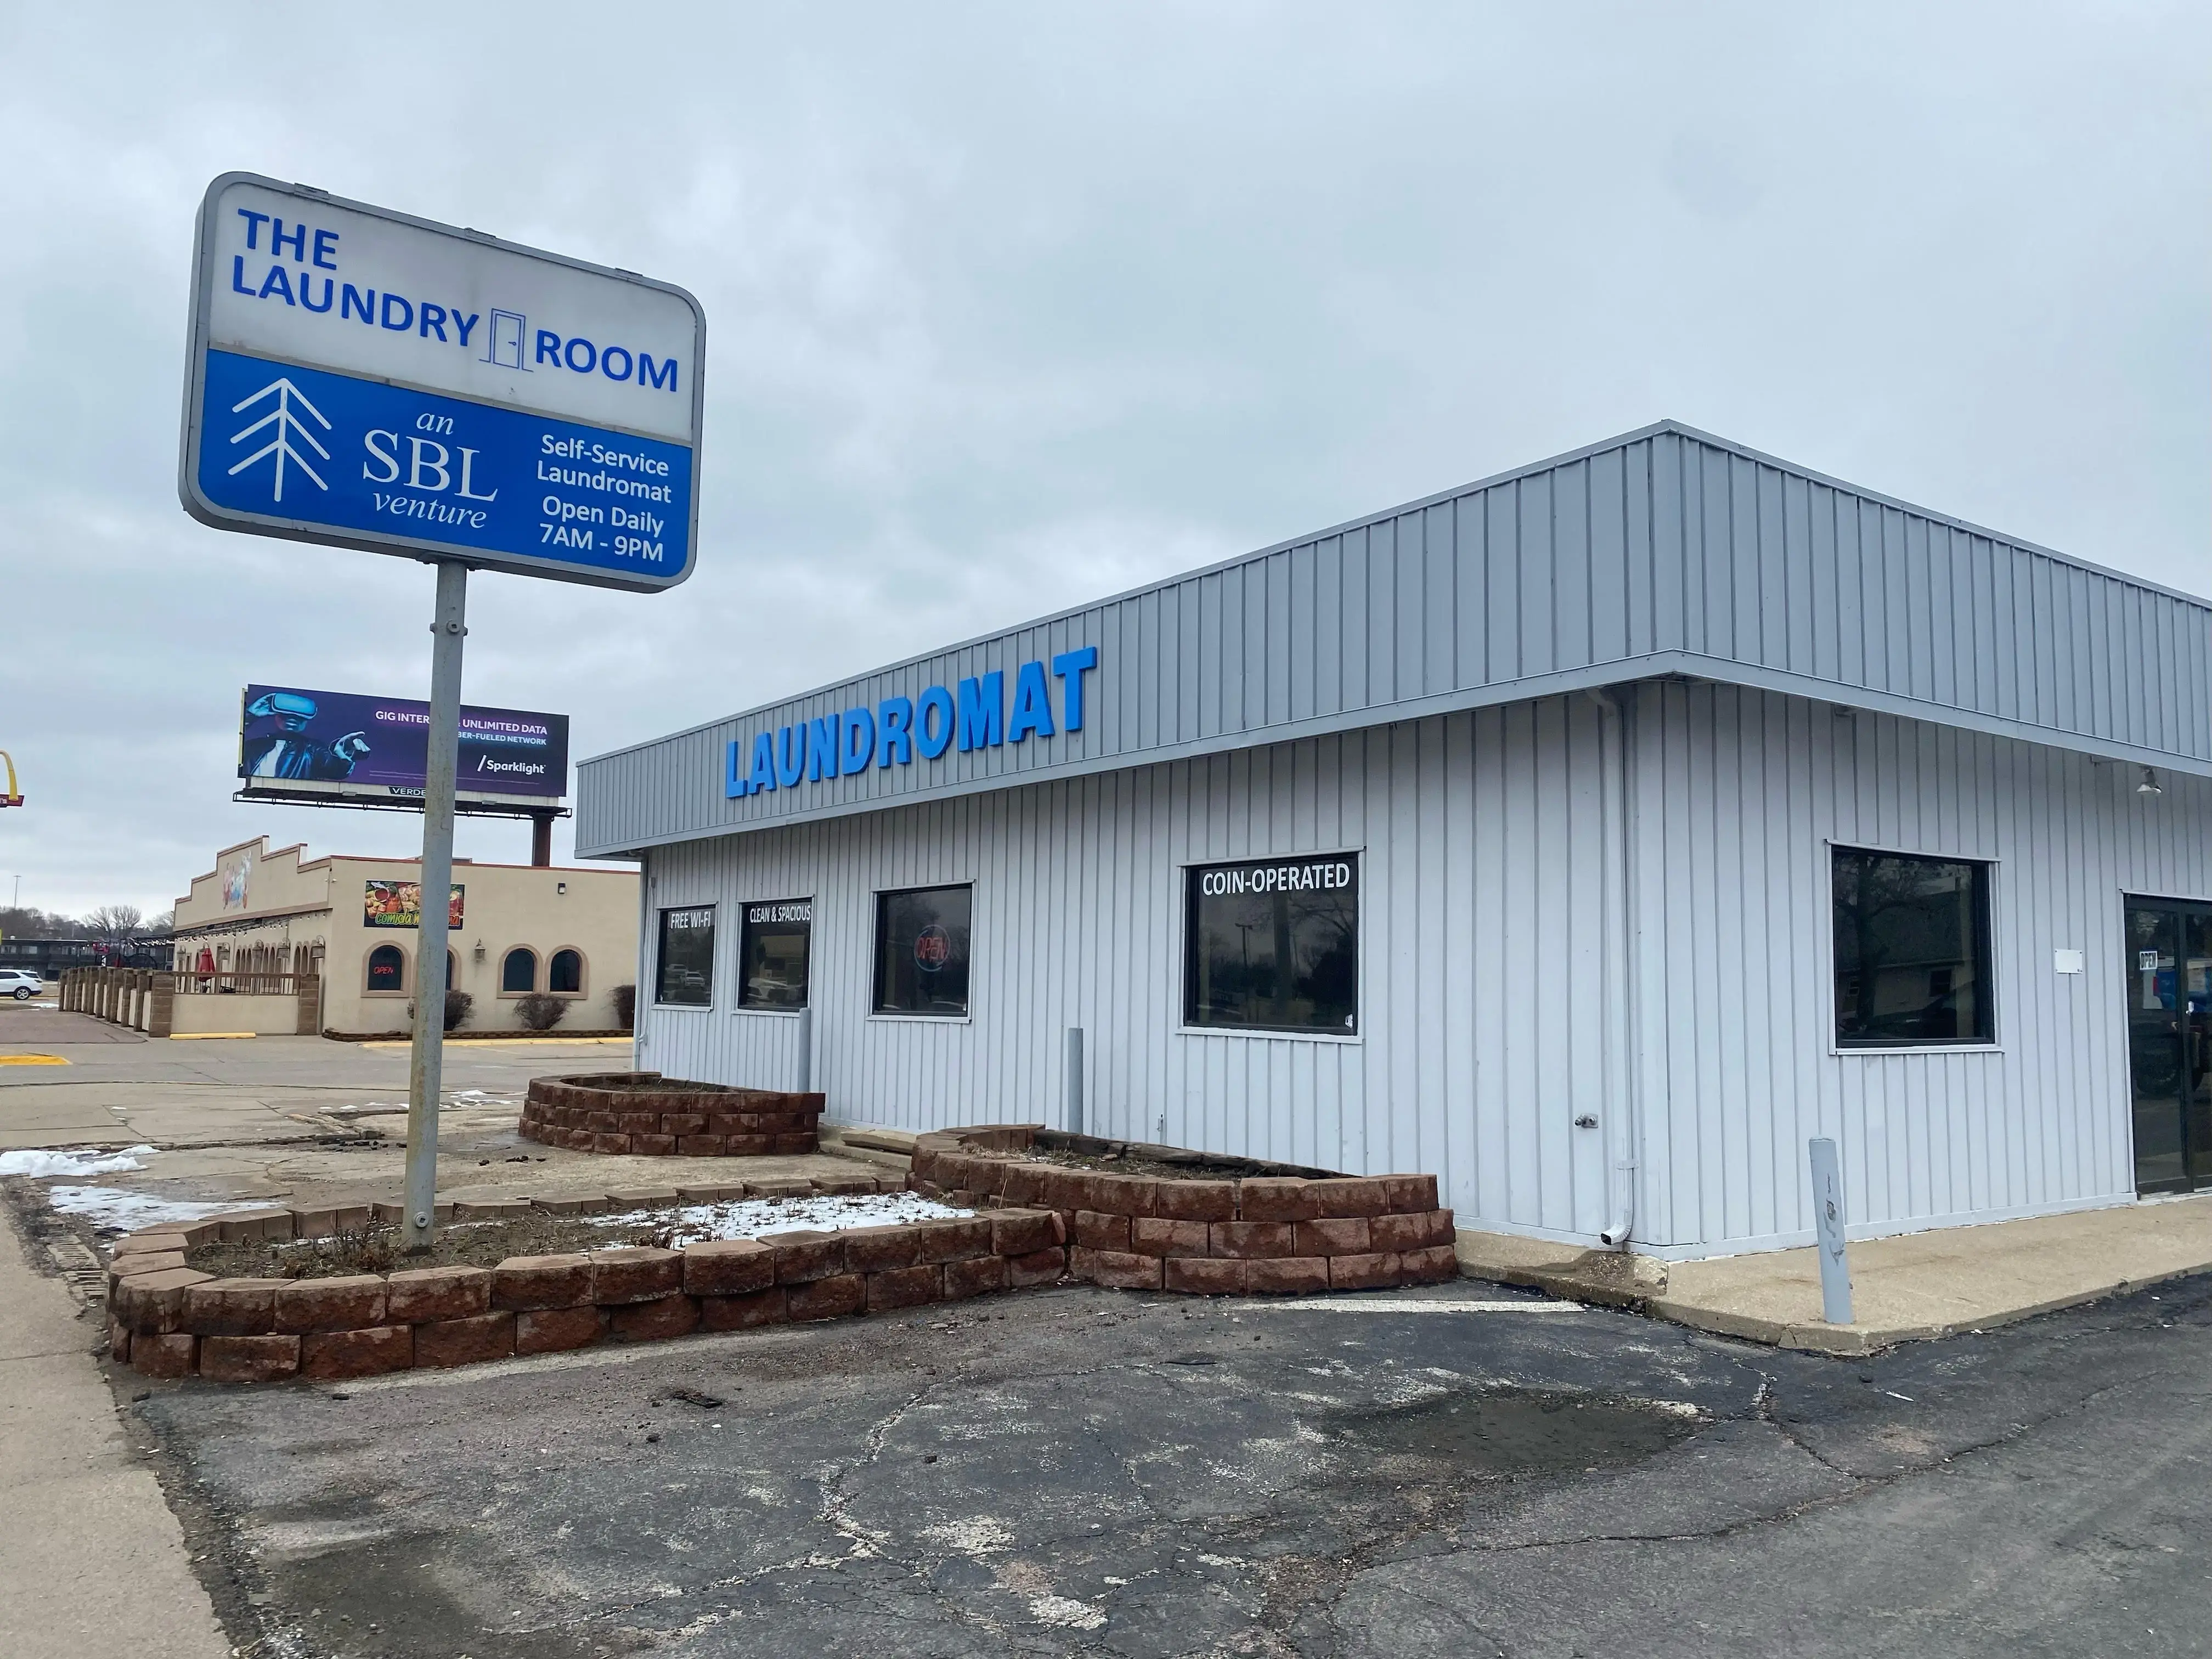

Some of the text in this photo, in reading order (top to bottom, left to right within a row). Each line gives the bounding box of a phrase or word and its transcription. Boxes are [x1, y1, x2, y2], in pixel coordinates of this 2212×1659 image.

[238, 208, 339, 270] THE
[233, 255, 678, 392] LAUNDRY ROOM
[416, 413, 454, 435] an
[363, 429, 498, 502] SBL
[541, 434, 669, 476] Self-Service
[537, 460, 672, 504] Laundromat
[373, 493, 487, 529] venture
[543, 495, 664, 538] Open Daily
[540, 523, 593, 551] 7AM
[614, 535, 663, 562] 9PM
[375, 710, 548, 735] GIG INTER UNLIMITED DATA
[458, 731, 547, 746] BER-FUELED NETWORK
[726, 646, 1097, 799] LAUNDROMAT
[1202, 862, 1350, 896] COIN-OPERATED
[375, 907, 412, 926] comida
[670, 911, 711, 929] FREE WI-FI
[749, 905, 811, 923] CLEAN & SPACIOUS
[916, 937, 947, 960] OPEN
[374, 966, 394, 974] OPEN
